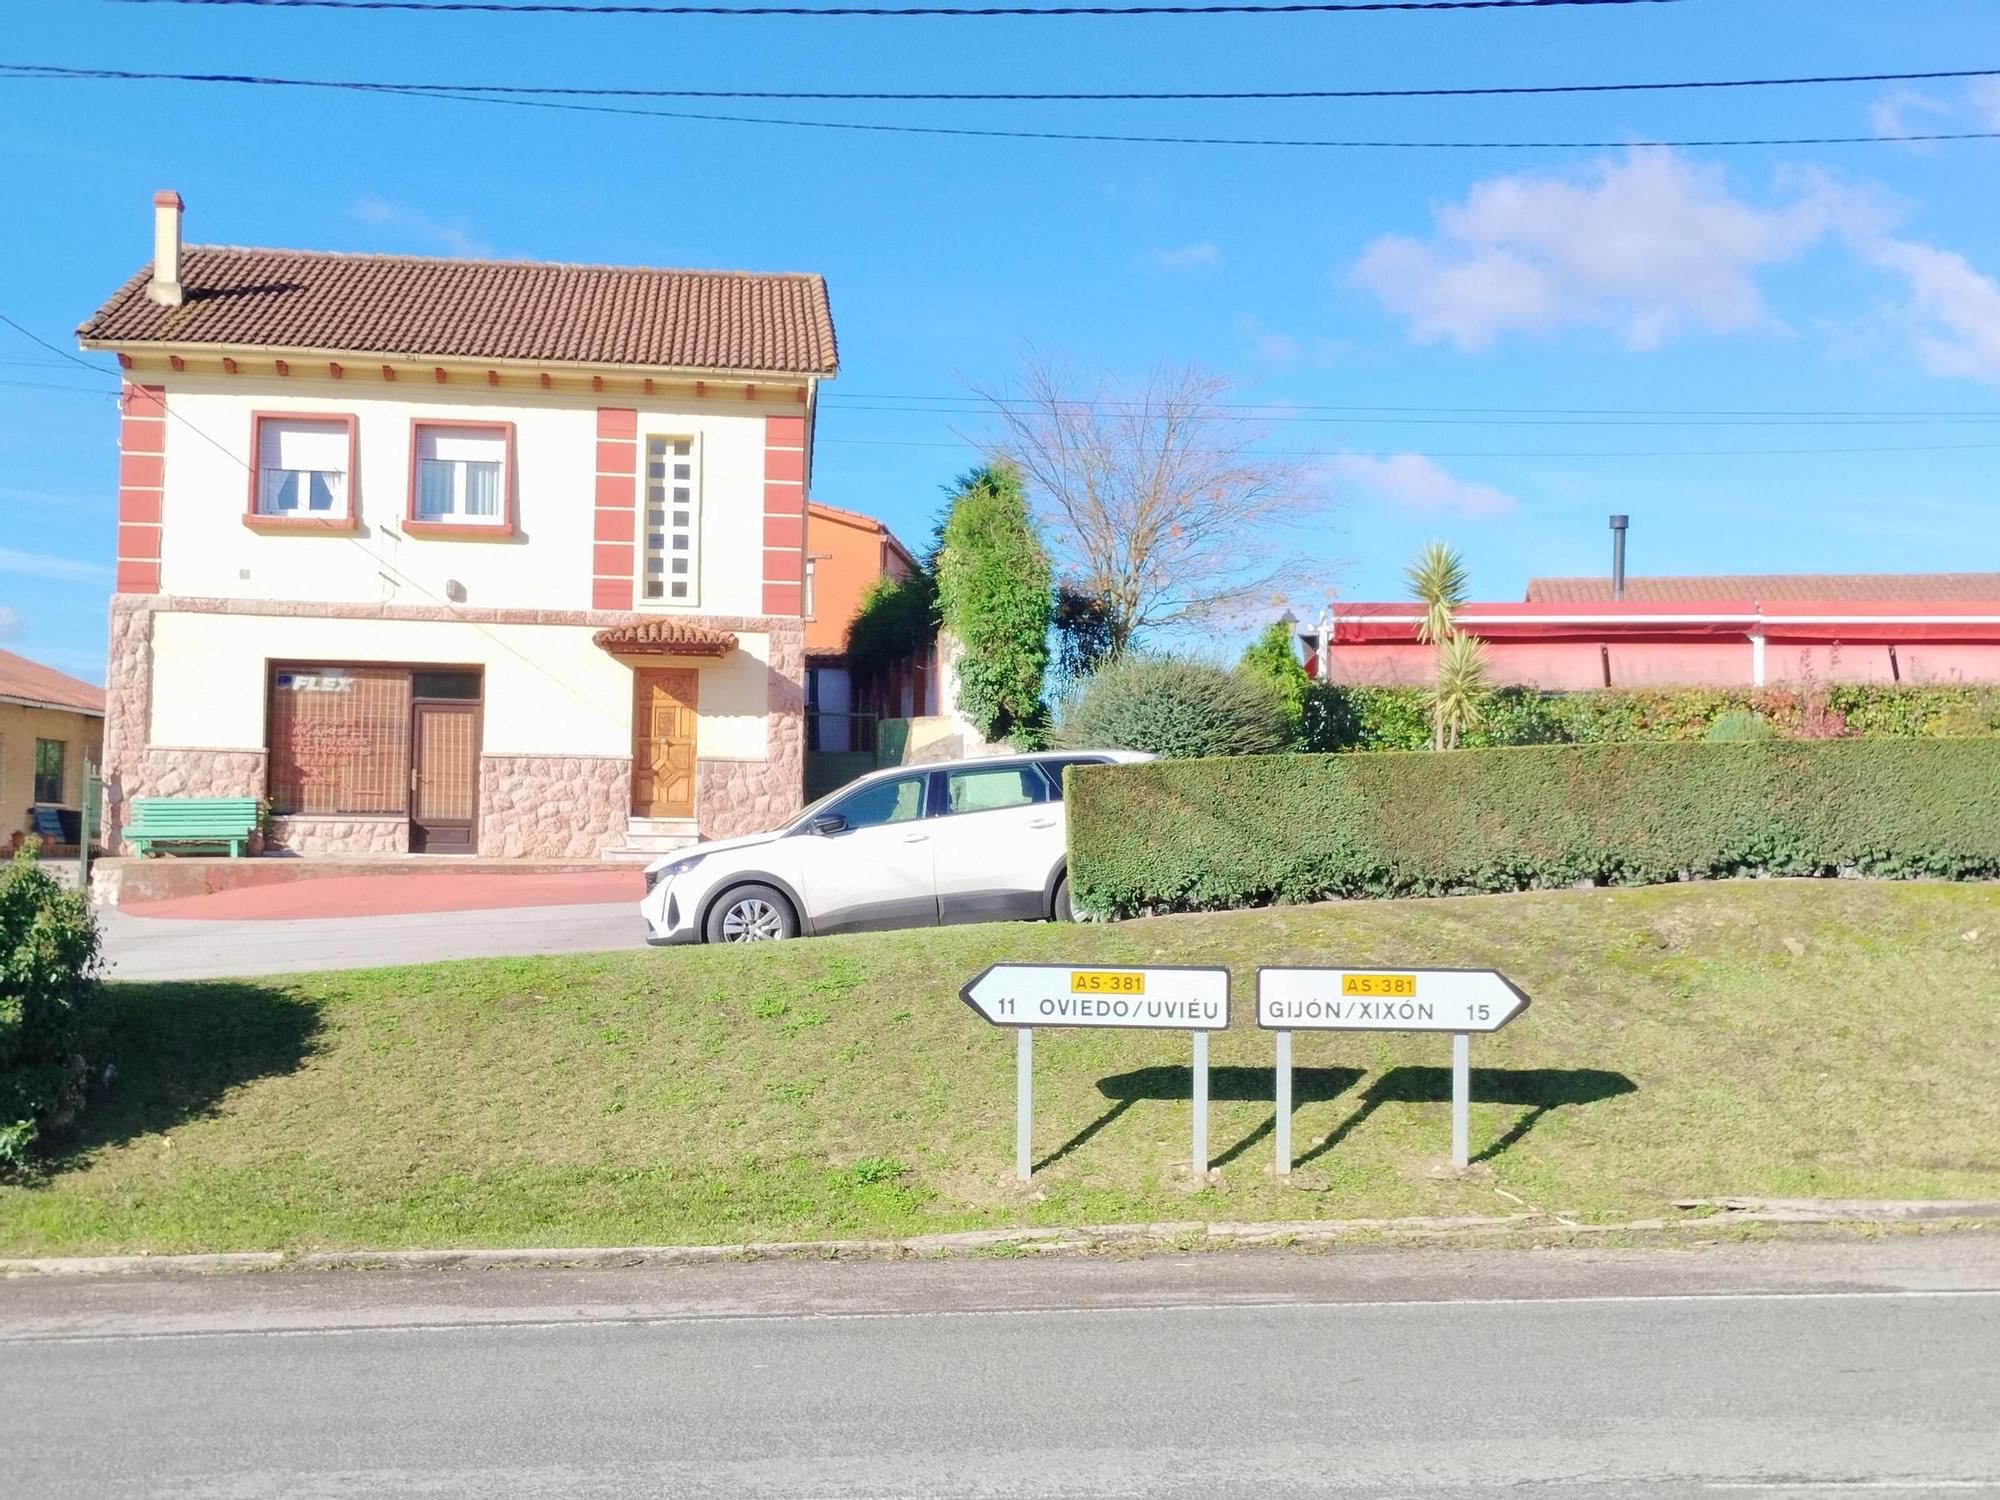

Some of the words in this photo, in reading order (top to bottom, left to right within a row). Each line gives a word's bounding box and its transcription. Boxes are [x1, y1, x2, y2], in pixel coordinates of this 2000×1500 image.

[292, 675, 352, 691] FLEX
[1075, 975, 1142, 991] AS-381
[1346, 978, 1413, 993] AS-381
[998, 998, 1016, 1015] 11
[1039, 998, 1219, 1019] OVIEDO/UVIÉU
[1269, 998, 1434, 1020] GIJÓN/XIXÓN
[1466, 1004, 1491, 1020] 15
